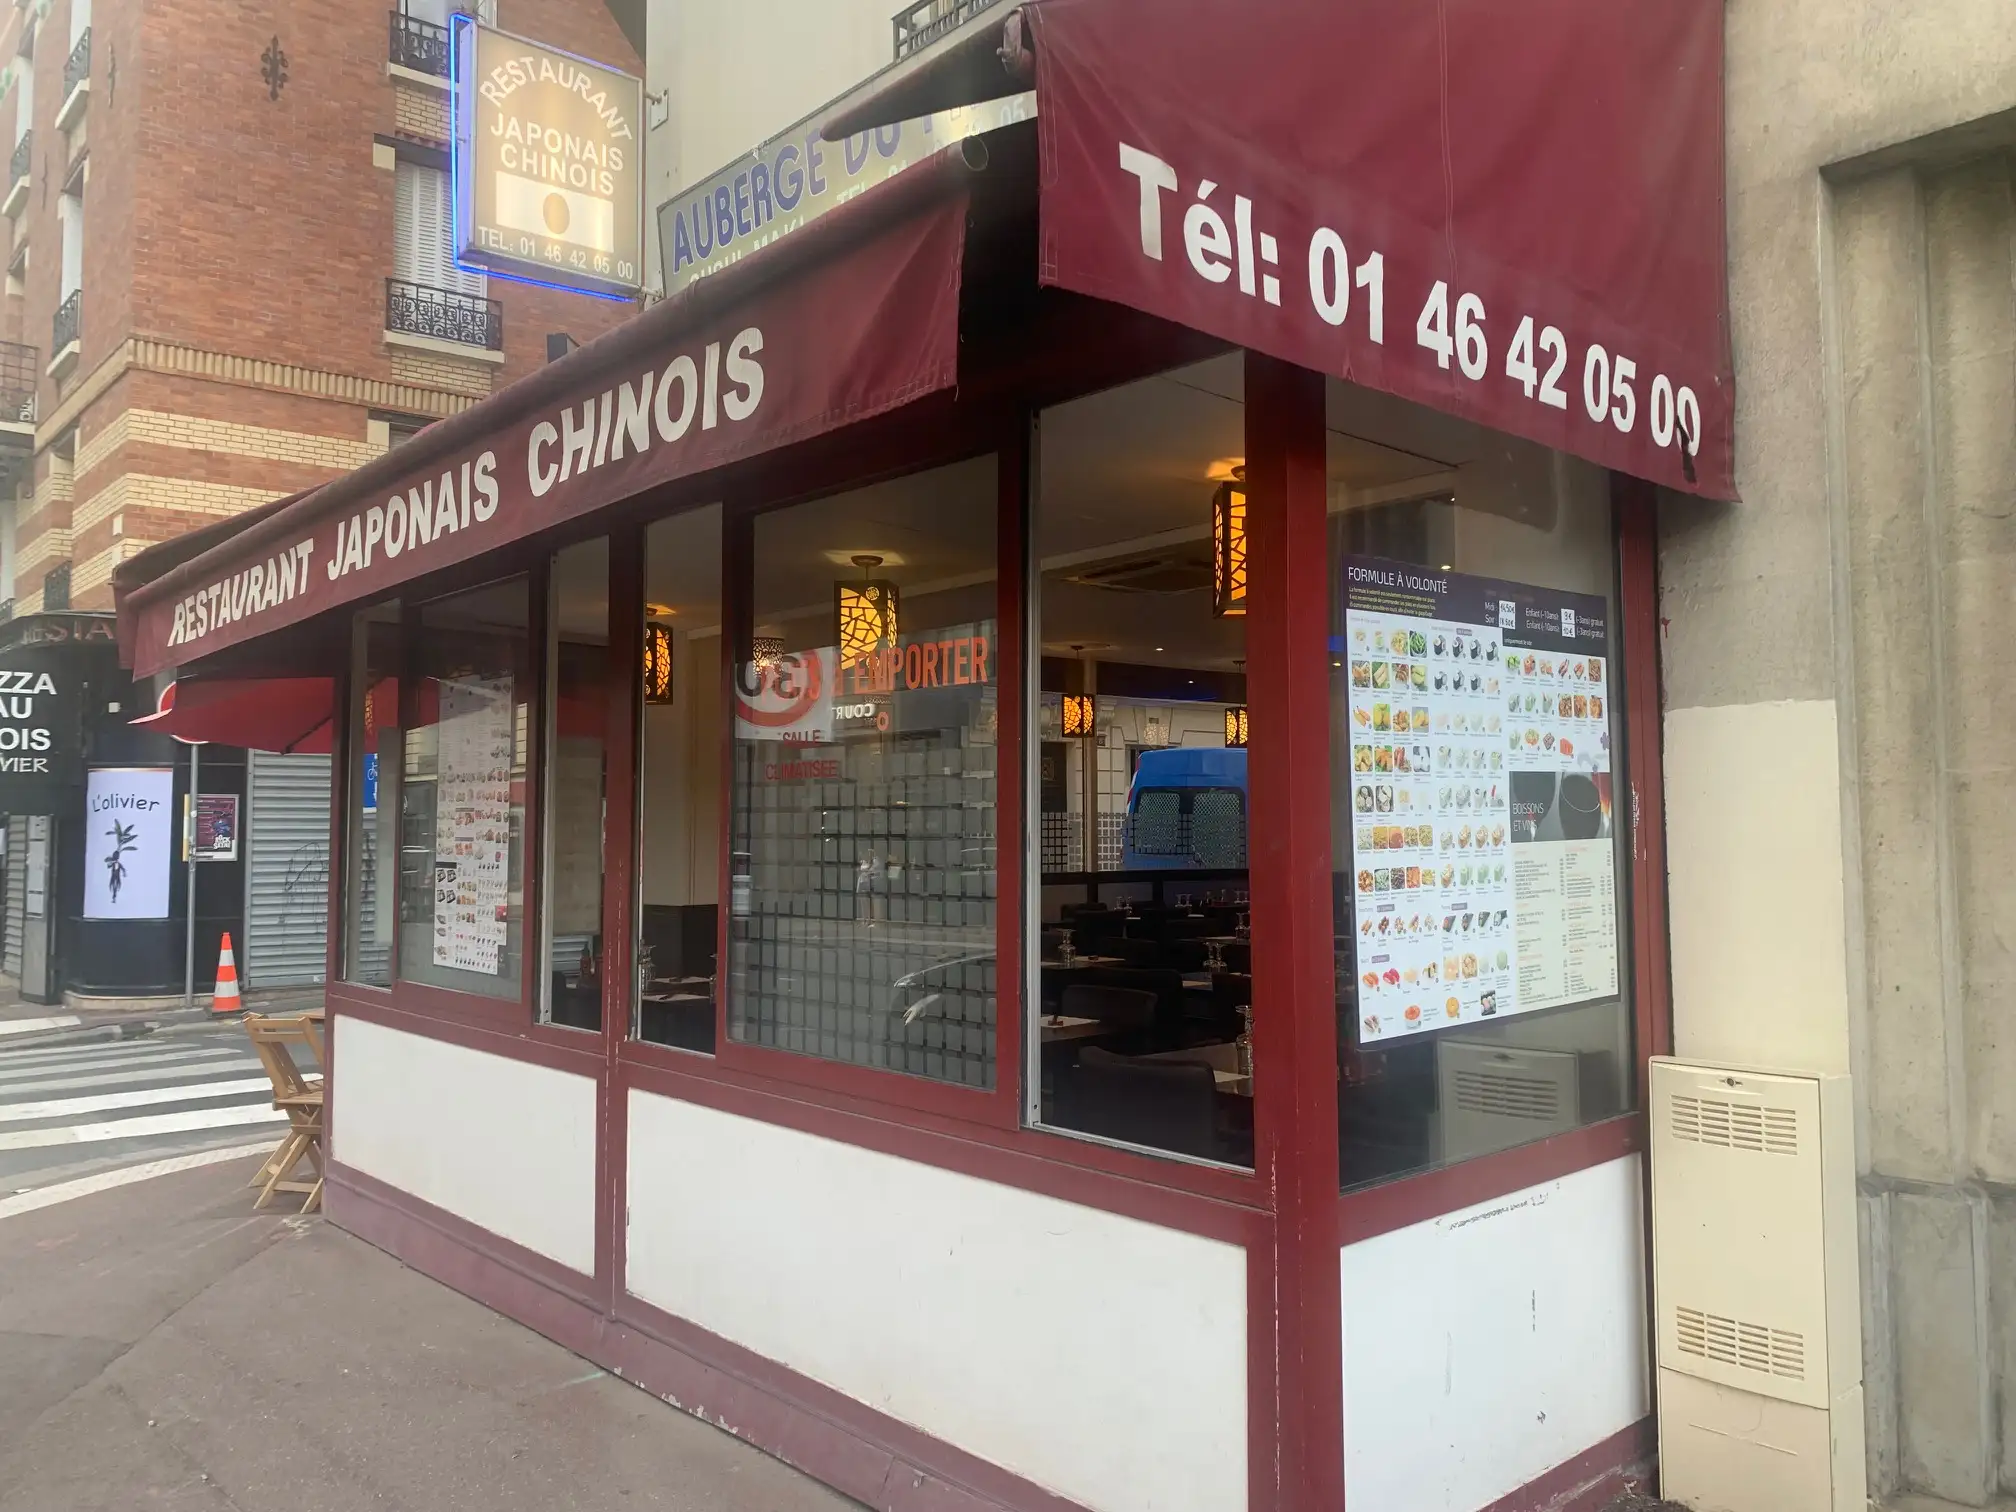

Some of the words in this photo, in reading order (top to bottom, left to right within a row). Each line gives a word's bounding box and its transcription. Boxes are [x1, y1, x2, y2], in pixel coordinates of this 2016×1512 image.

[480, 56, 633, 141] RESTAURANT
[490, 112, 624, 172] JAPONAIS
[501, 143, 614, 196] CHINOIS
[673, 128, 828, 274] AUBERGE
[520, 236, 536, 257] 01
[544, 243, 562, 263] 46
[570, 250, 587, 269] 42
[593, 255, 610, 274] 05
[617, 260, 633, 280] 00
[1119, 141, 1281, 307] Tél:
[1308, 227, 1384, 345] 01
[1416, 280, 1488, 381] 46
[1506, 315, 1567, 410] 42
[1583, 344, 1636, 433] 05
[1650, 374, 1701, 456] 00
[167, 538, 314, 647] RESTAURANT
[327, 450, 499, 581] JAPONAIS
[527, 327, 764, 498] CHINOIS
[1348, 566, 1395, 586] FORMULE
[1397, 570, 1404, 588] À
[1405, 575, 1448, 594] VOLONTÉ
[854, 636, 989, 695] EMPORTER
[92, 793, 160, 812] L'olivier
[1512, 802, 1545, 815] BOISSONS
